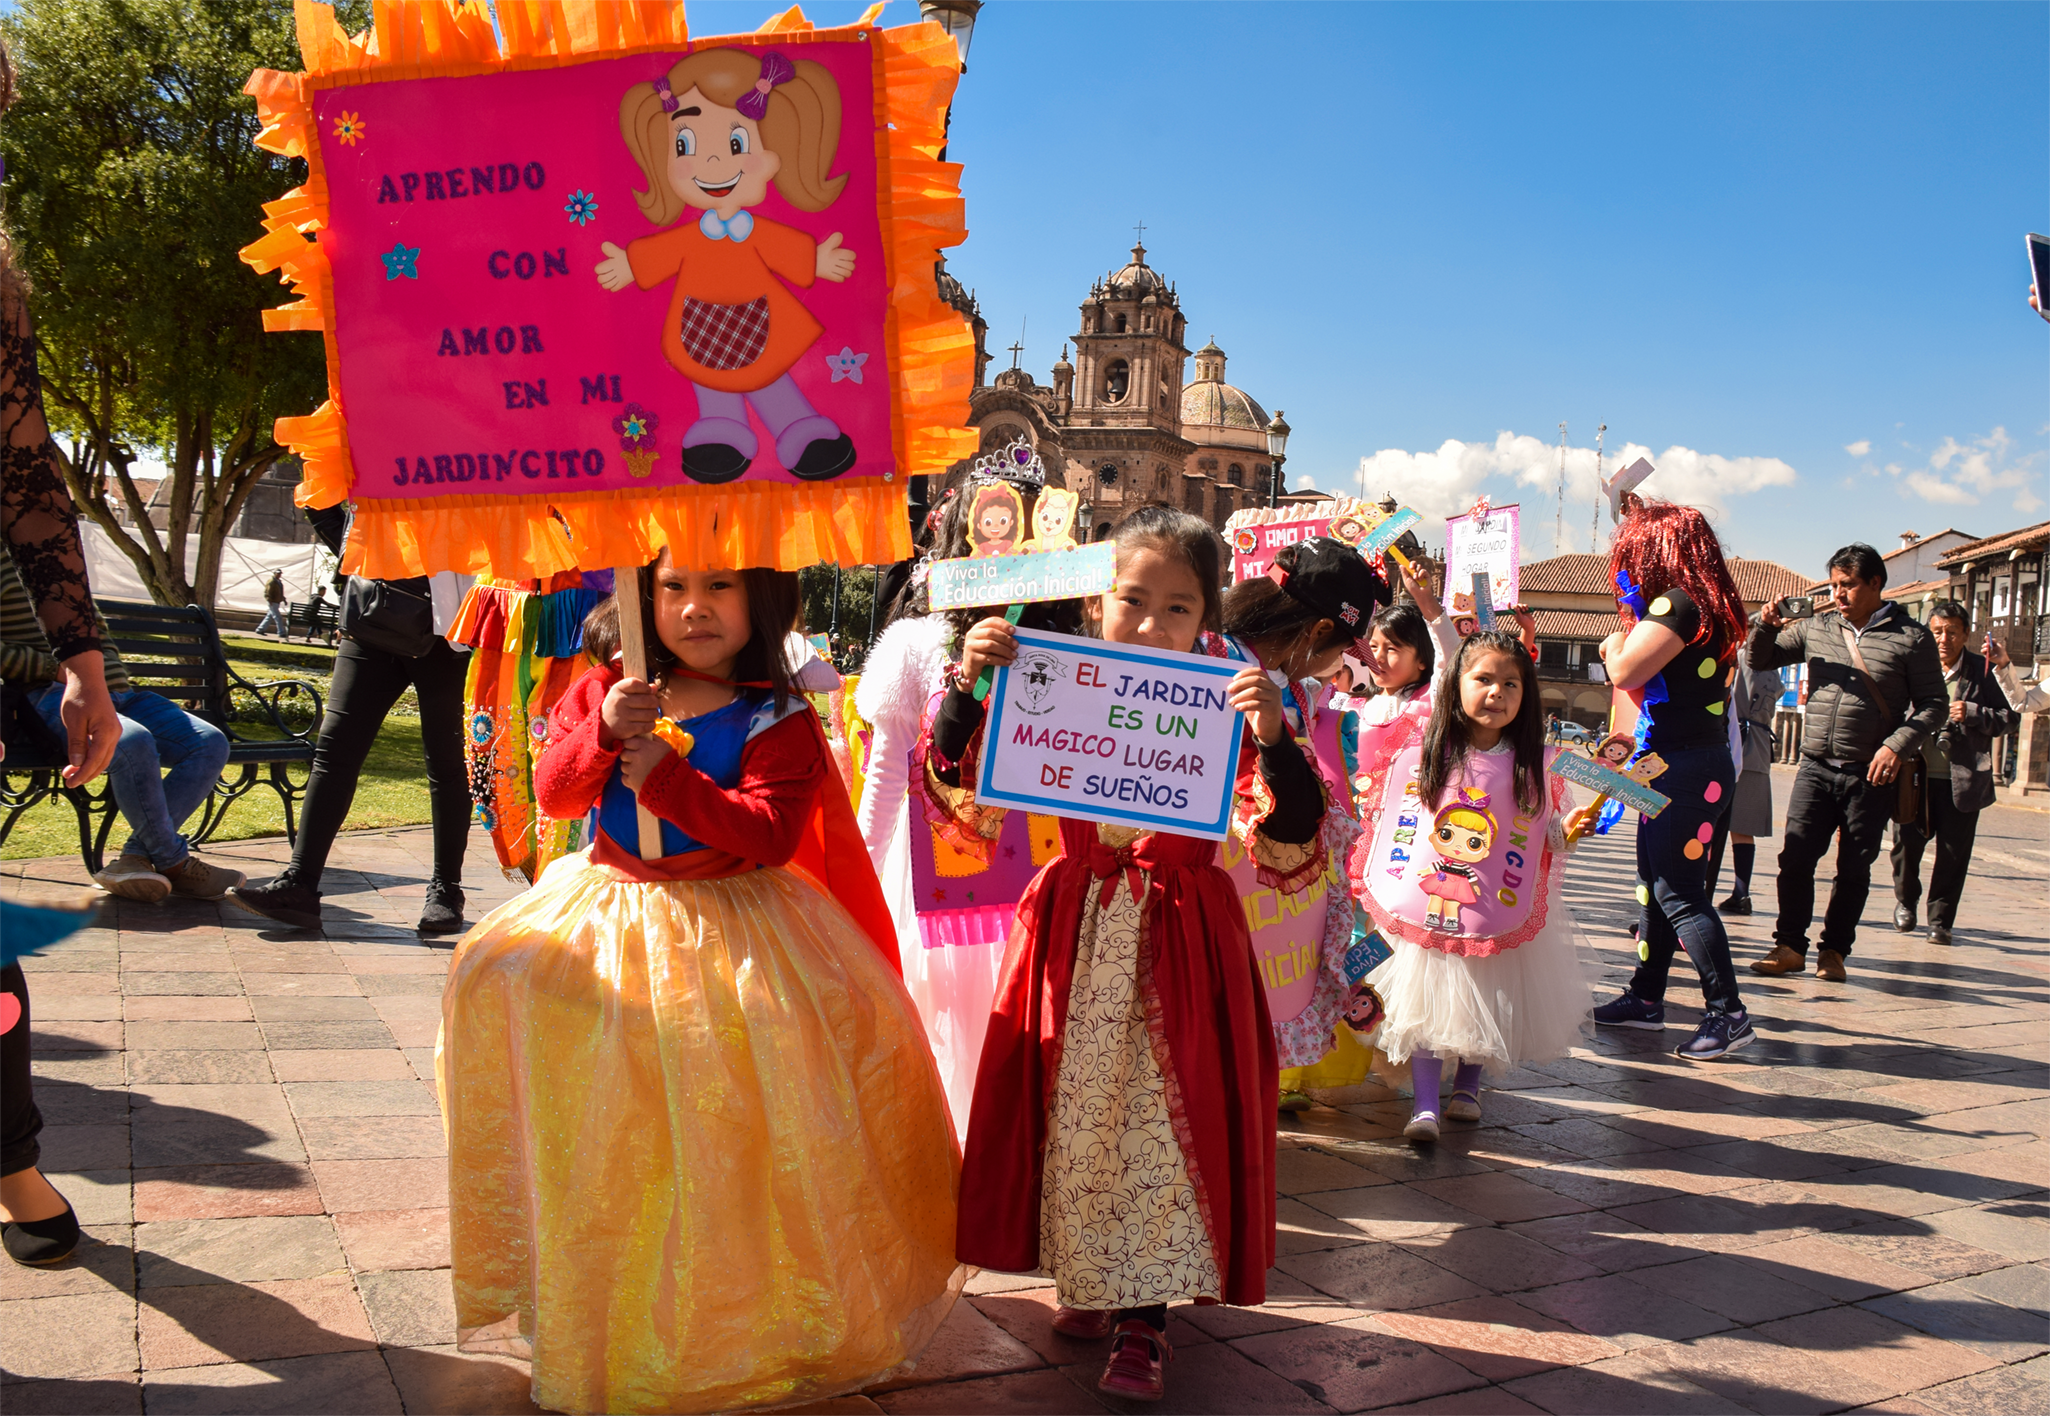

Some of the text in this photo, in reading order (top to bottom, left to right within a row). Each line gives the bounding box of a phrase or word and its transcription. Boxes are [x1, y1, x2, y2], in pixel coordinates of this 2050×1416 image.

[377, 161, 546, 204] APRENDO
[488, 248, 570, 280] CON
[437, 325, 544, 356] AMOR
[503, 374, 623, 409] EN MI
[393, 448, 605, 486] JARDINCITO
[1265, 528, 1298, 548] AMO
[1467, 539, 1507, 554] SEGUNDO
[940, 562, 998, 587] ¡Viva la
[944, 567, 1102, 604] Educación Inicial!
[1242, 561, 1265, 580] MI
[1347, 606, 1360, 616] OH
[1076, 662, 1226, 711] EL JARDIN
[1108, 705, 1198, 739] ES UN
[1012, 723, 1205, 777] MAGICO LUGAR
[1040, 764, 1189, 809] DE SUEÑOS
[1560, 764, 1654, 812] Educación Inicial!
[1590, 766, 1600, 776] la
